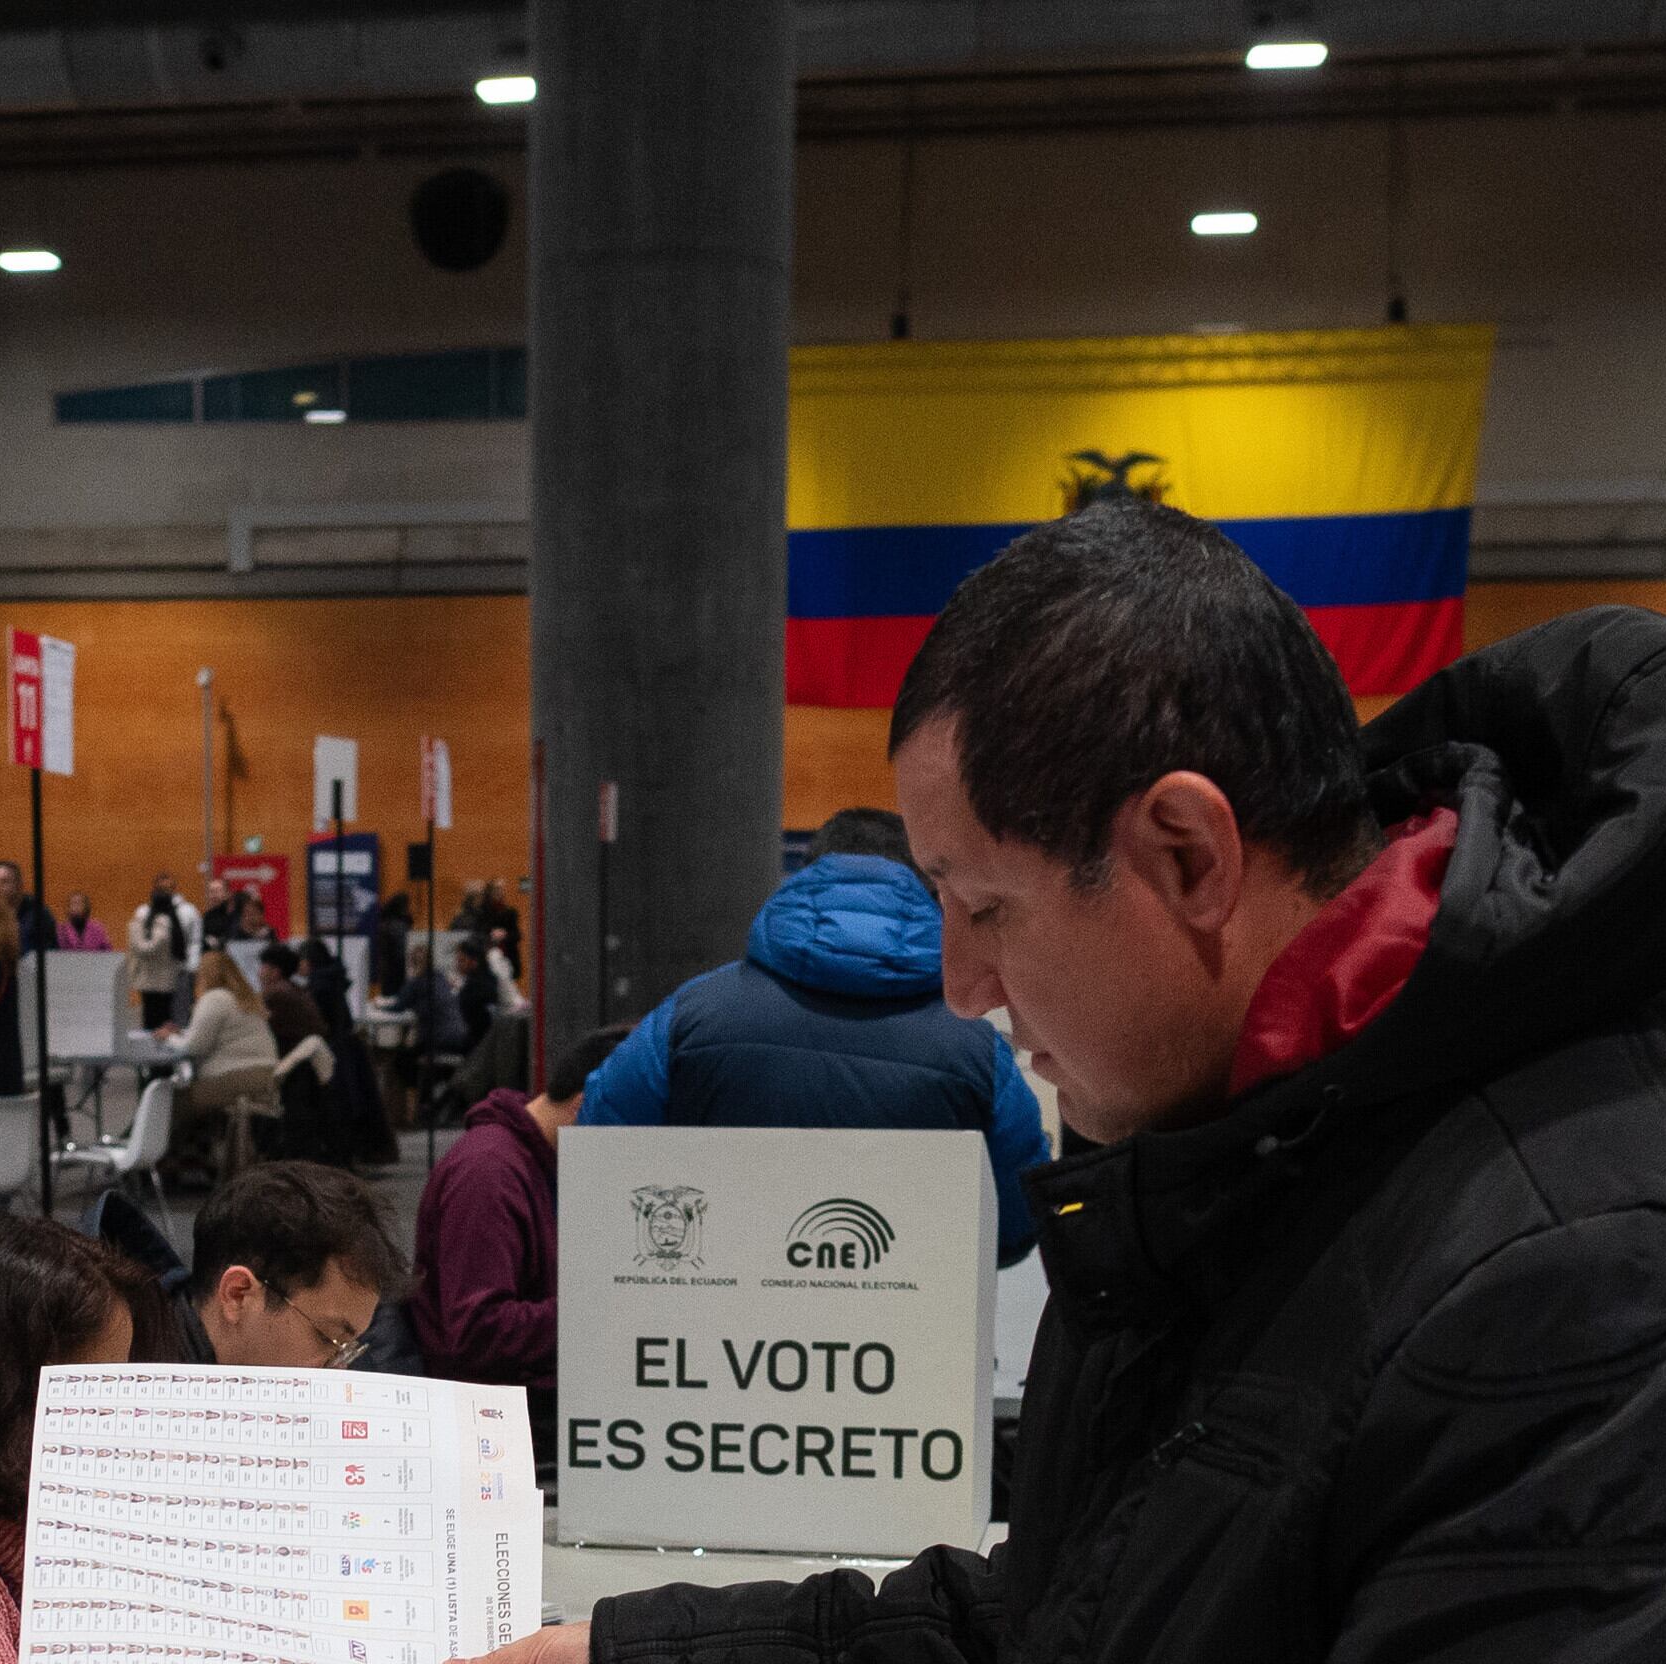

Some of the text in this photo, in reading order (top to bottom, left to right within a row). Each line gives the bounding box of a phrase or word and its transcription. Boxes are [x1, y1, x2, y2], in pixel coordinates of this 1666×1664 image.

[669, 1276, 688, 1286] DEL
[690, 1276, 737, 1287] ECUADOR
[761, 1278, 919, 1291] CONSEJO NACIONAL ELECTORAL
[635, 1337, 896, 1394] EL VOTO
[568, 1418, 964, 1481] ES SECRETO
[446, 1508, 455, 1520] SE
[446, 1523, 456, 1550] ELIGE
[447, 1552, 456, 1574] UNA
[446, 1577, 456, 1590] (1)
[495, 1532, 512, 1619] ELECCIONES
[448, 1593, 457, 1622] LISTA
[449, 1624, 458, 1637] DE
